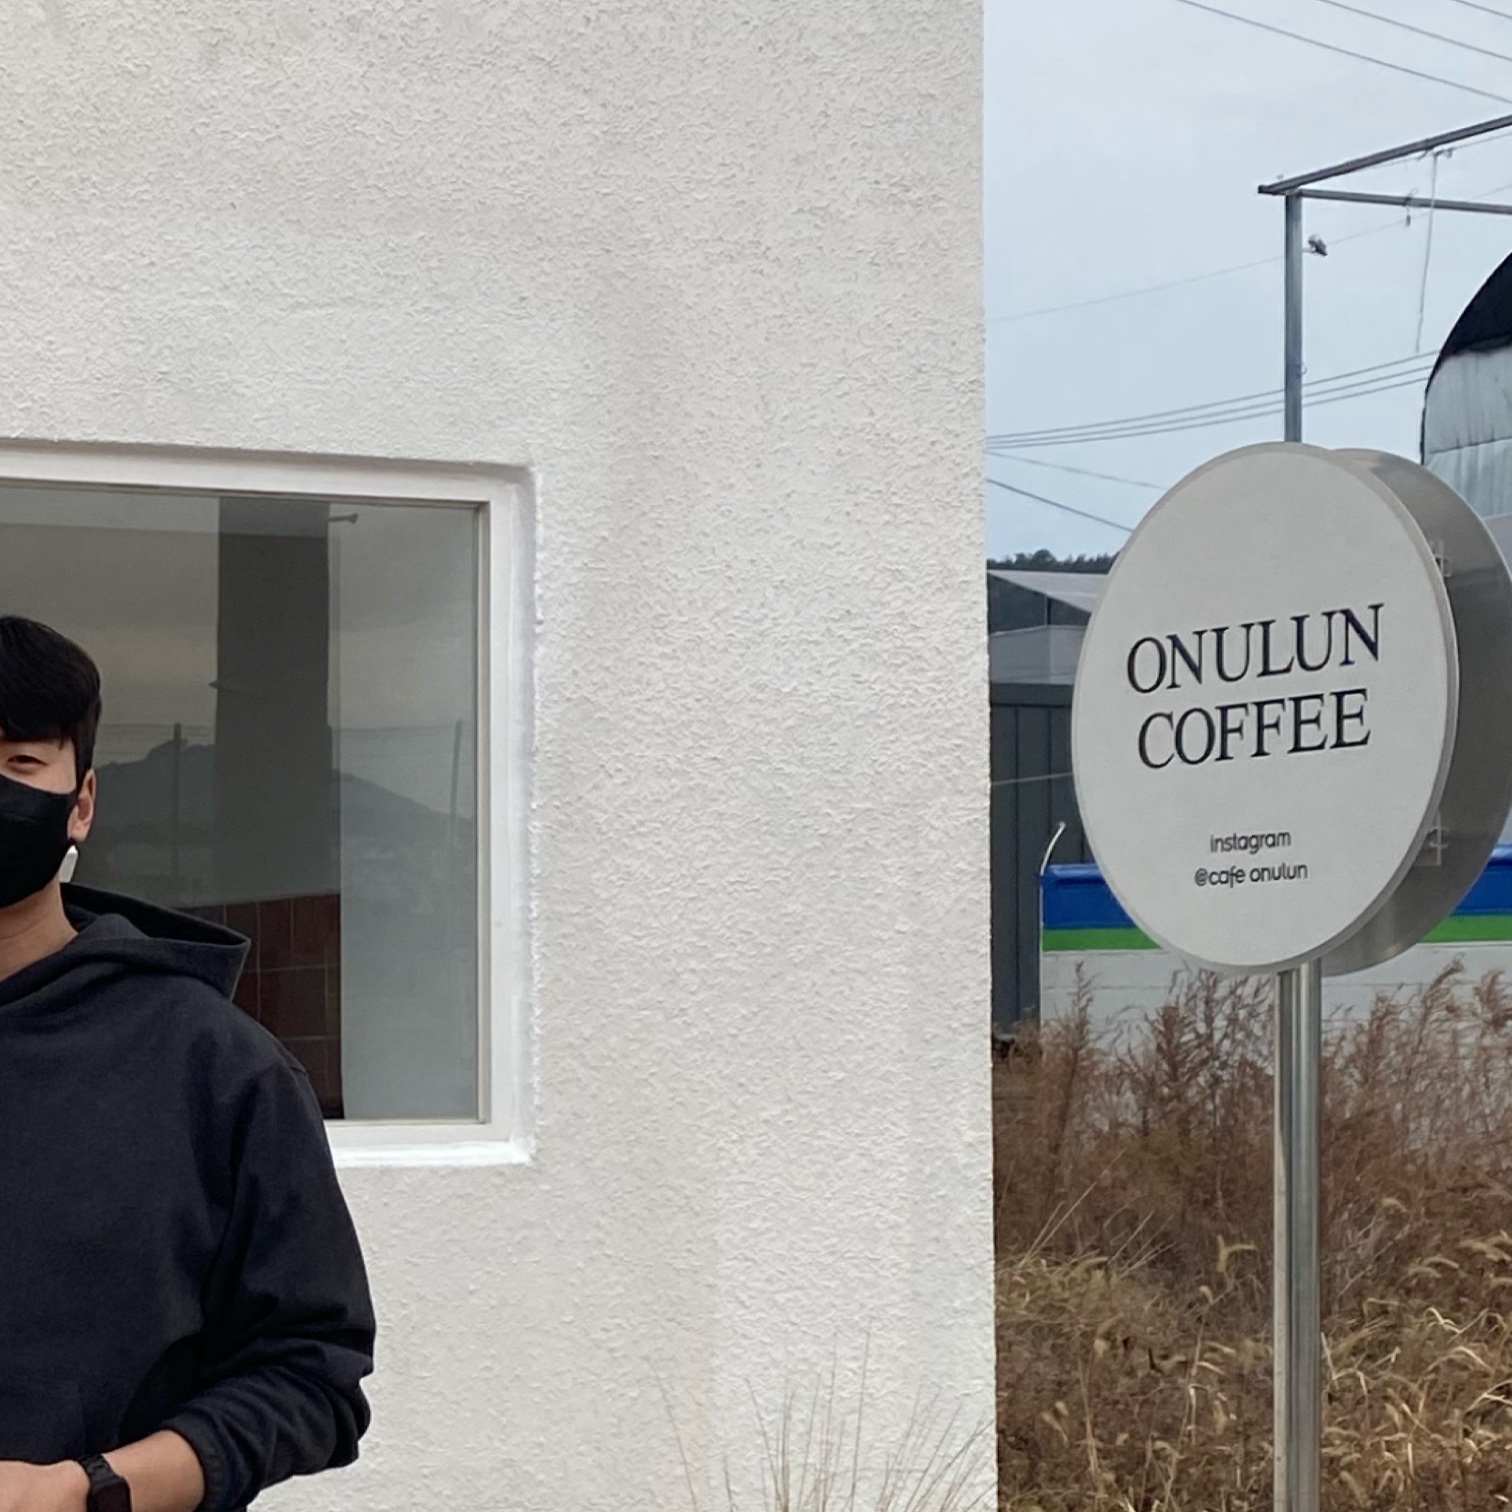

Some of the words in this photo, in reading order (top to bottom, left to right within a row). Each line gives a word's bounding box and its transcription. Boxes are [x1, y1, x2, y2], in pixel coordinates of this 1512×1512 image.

[1126, 602, 1385, 693] ONULUN
[1138, 688, 1371, 770] COFFEE
[1210, 831, 1292, 855] instagram
[1194, 865, 1246, 889] @cafe
[1249, 862, 1308, 882] onulun
